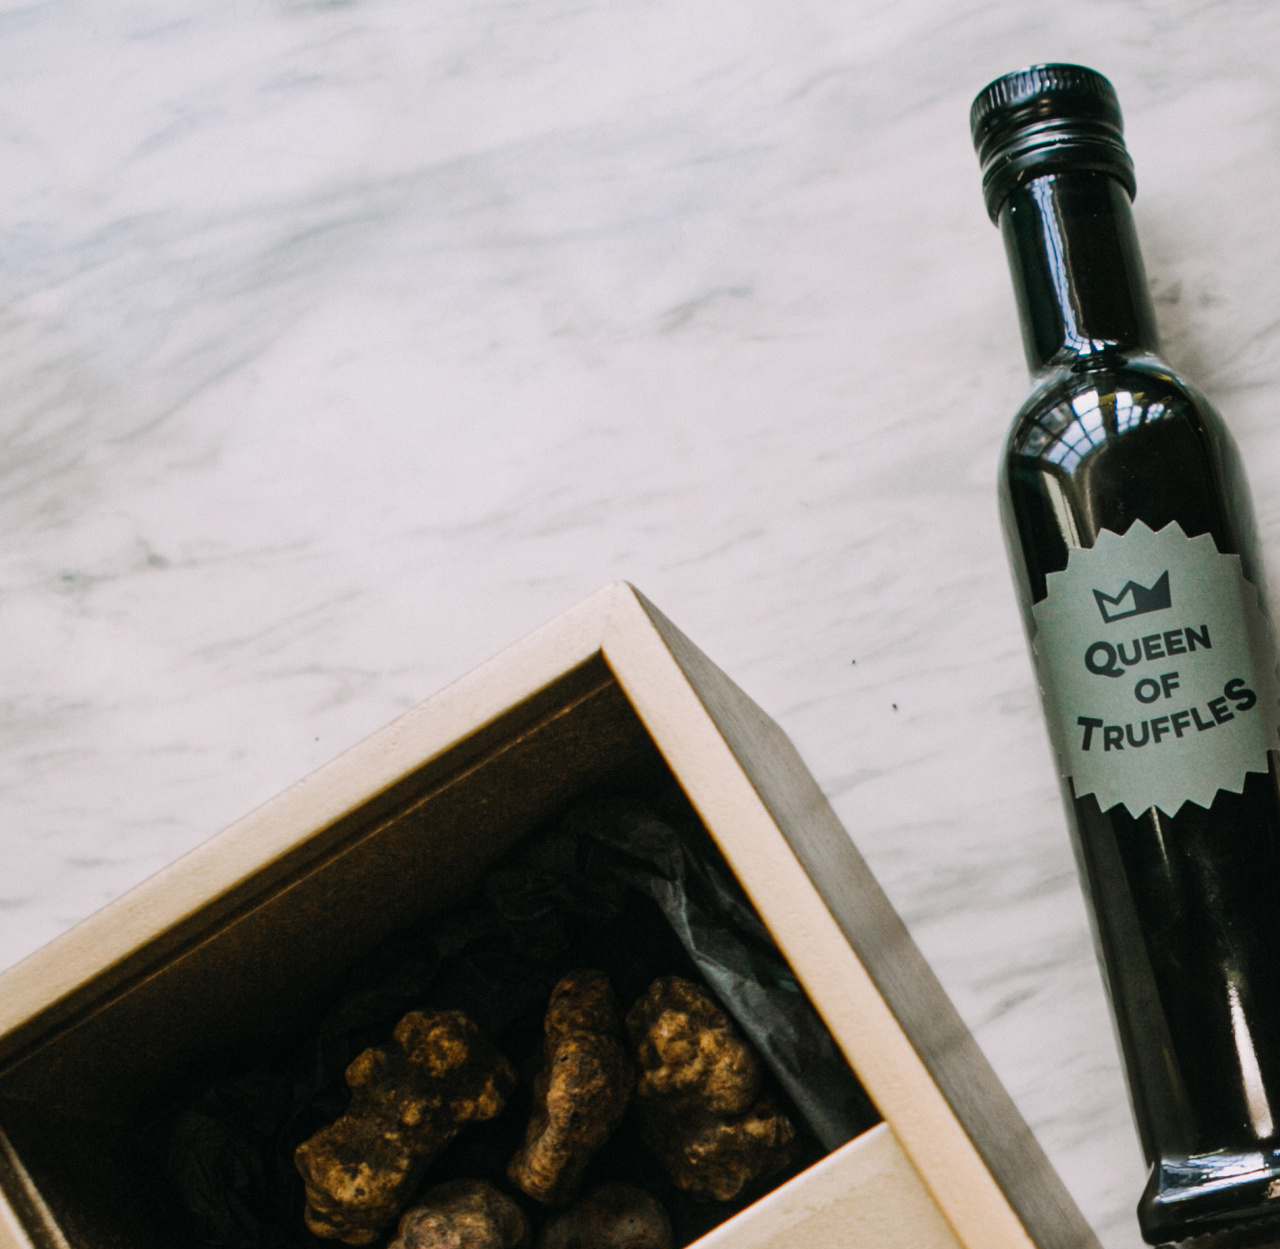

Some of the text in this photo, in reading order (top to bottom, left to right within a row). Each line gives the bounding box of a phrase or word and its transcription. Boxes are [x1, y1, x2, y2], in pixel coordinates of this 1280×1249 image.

[1084, 624, 1212, 678] QUEEN
[1134, 671, 1180, 704] OF
[1077, 678, 1257, 752] TRUFFLES
